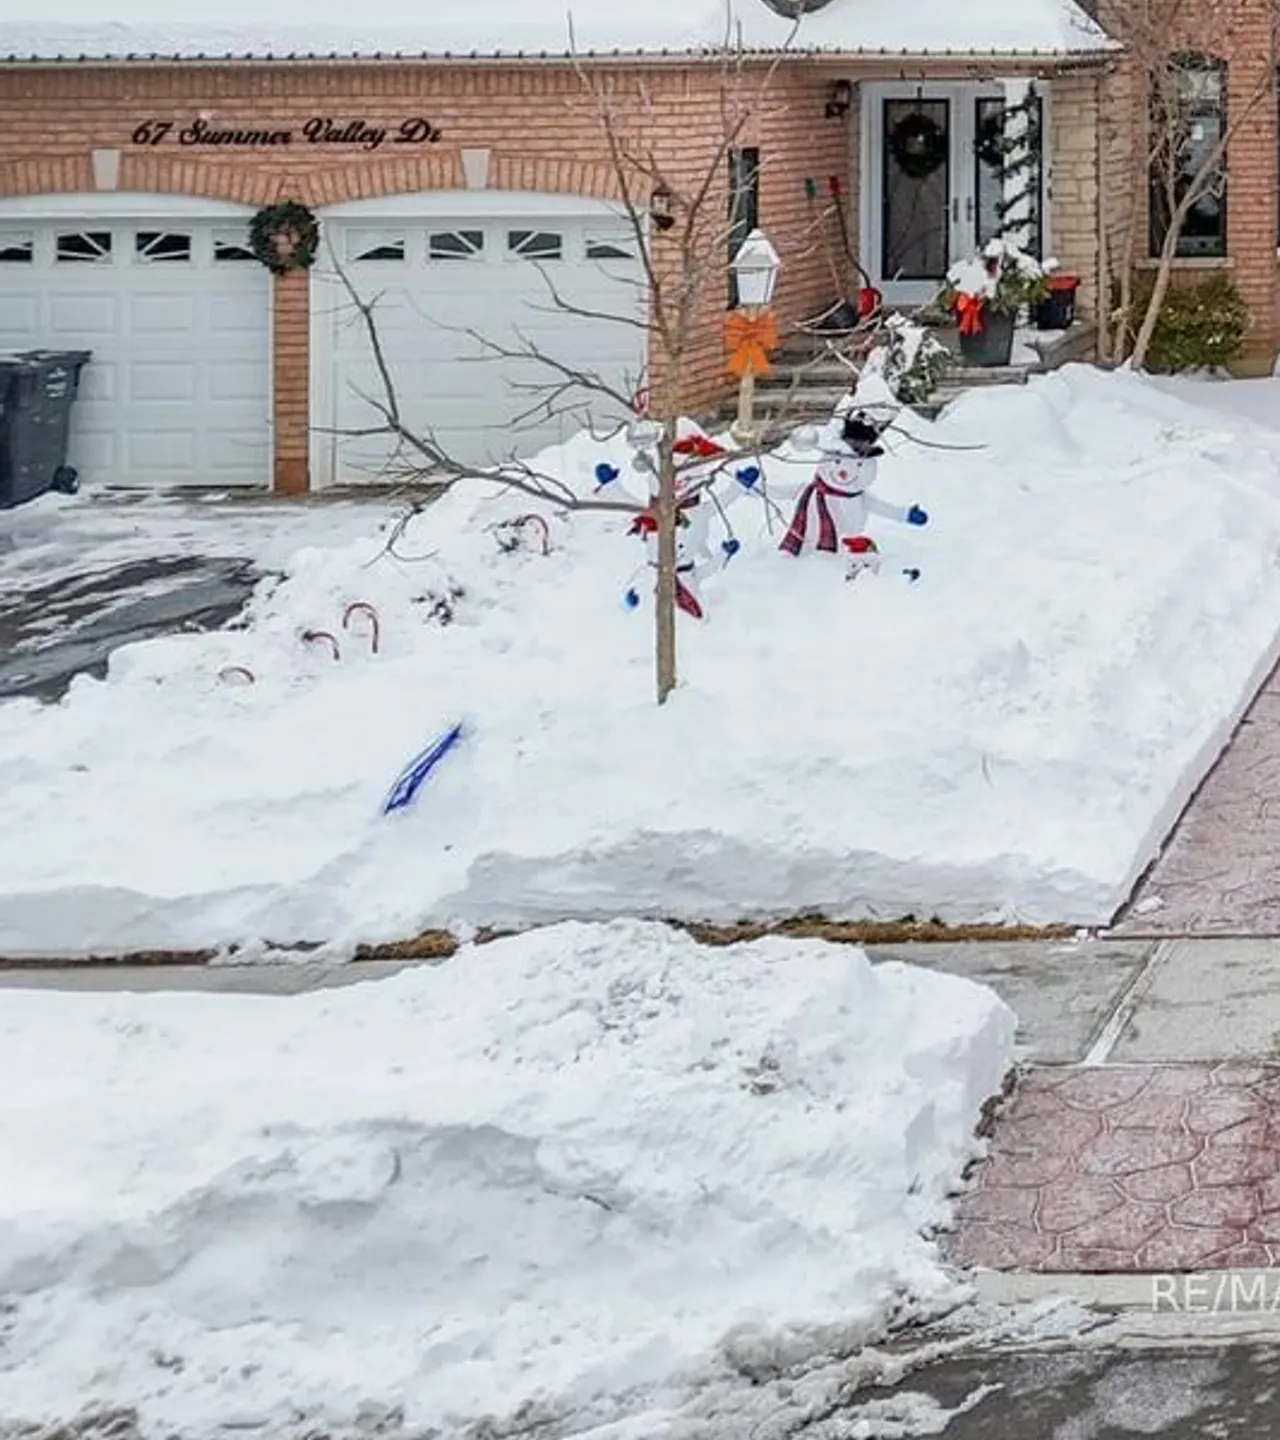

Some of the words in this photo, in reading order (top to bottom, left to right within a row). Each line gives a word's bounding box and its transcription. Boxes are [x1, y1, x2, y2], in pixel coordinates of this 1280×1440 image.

[132, 119, 173, 146] 67
[179, 119, 291, 146] Summer
[303, 118, 386, 150] Valley
[397, 118, 443, 144] Dr
